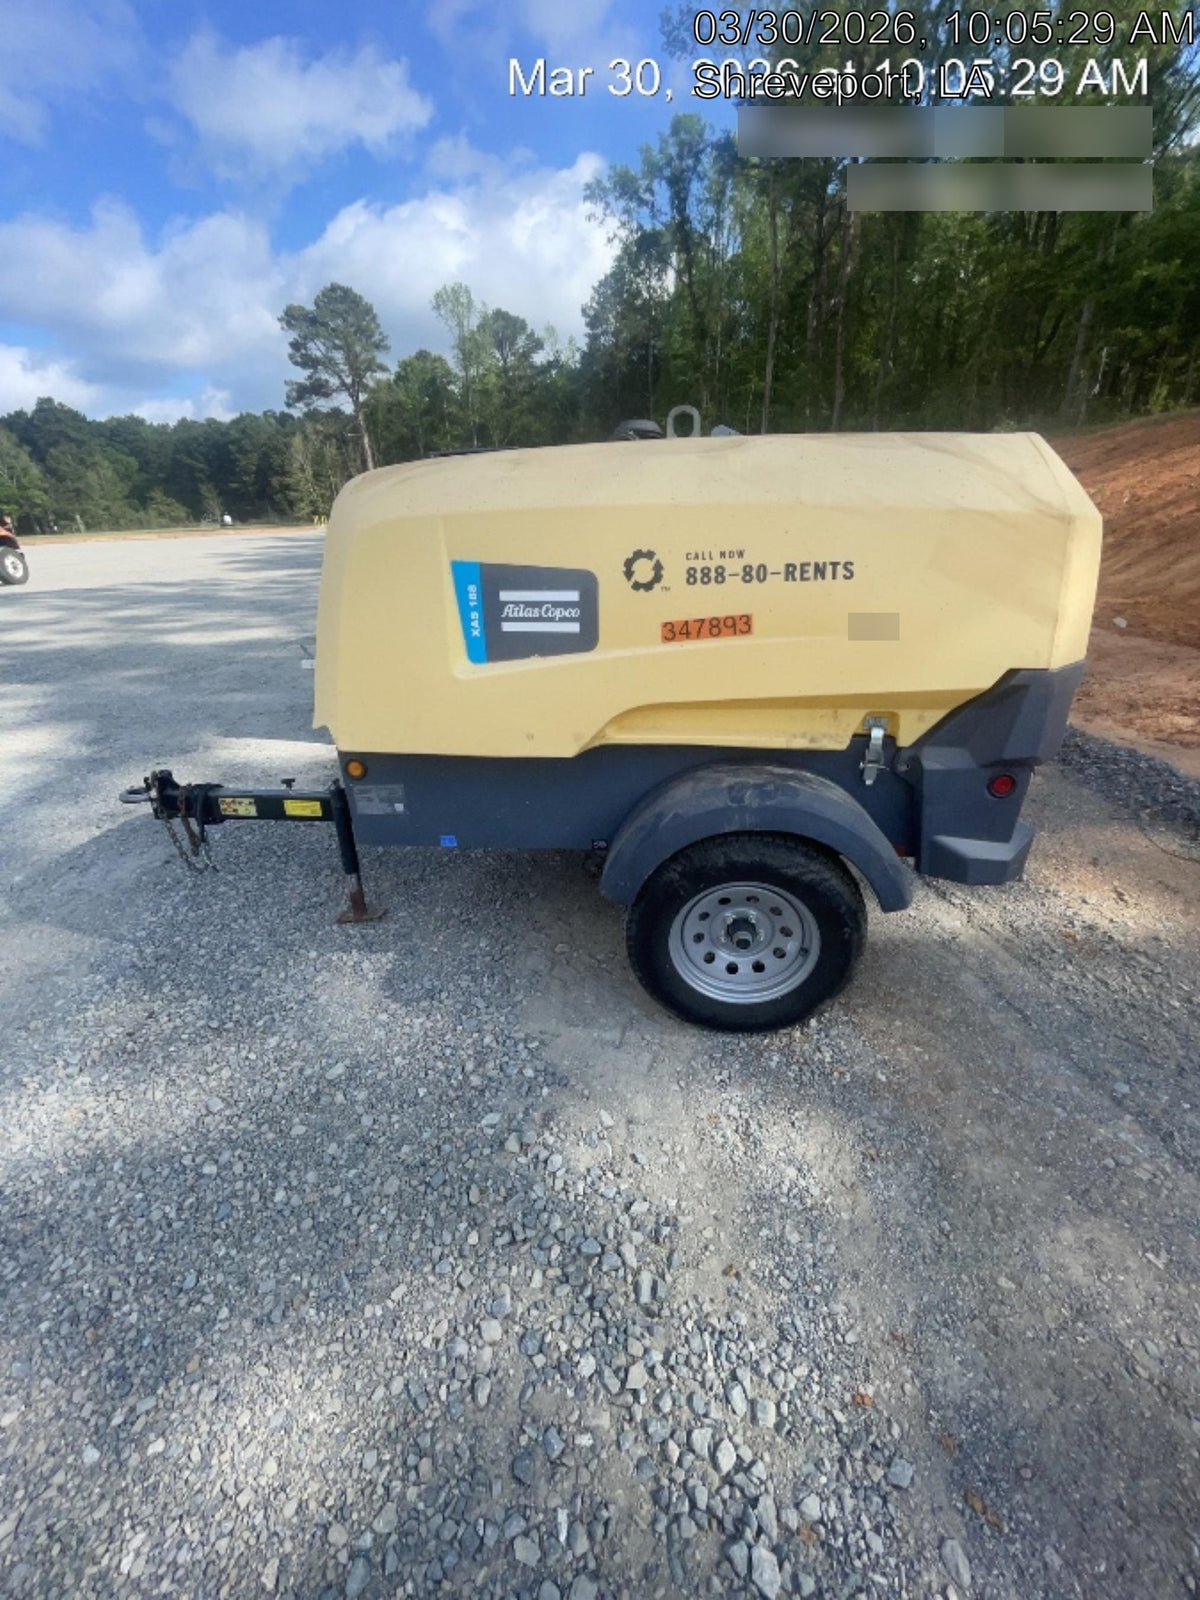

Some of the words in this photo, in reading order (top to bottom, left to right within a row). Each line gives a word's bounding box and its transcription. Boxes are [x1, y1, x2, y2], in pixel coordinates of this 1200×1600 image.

[685, 551, 714, 561] CALL
[719, 549, 746, 560] NOW
[685, 561, 855, 586] 888-80-RENTS
[467, 584, 478, 607] 188
[501, 604, 540, 618] Atlas
[541, 604, 580, 621] Copco
[662, 614, 752, 641] 347893
